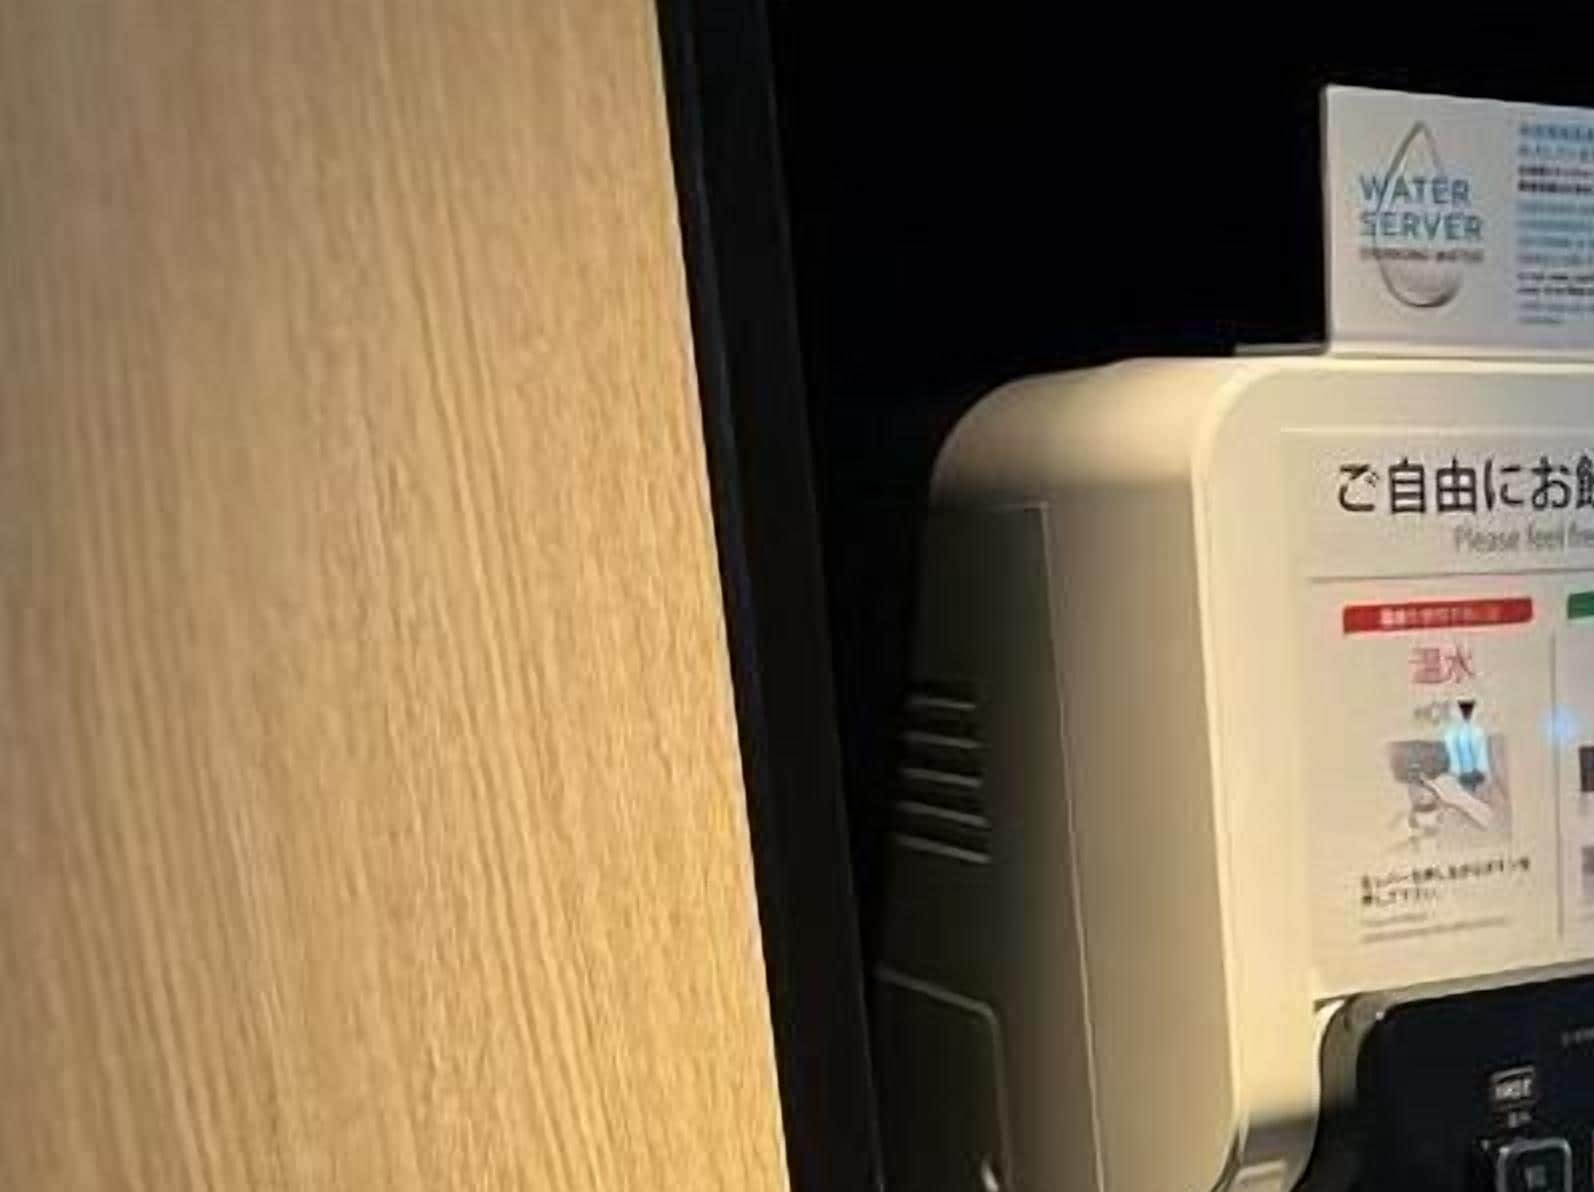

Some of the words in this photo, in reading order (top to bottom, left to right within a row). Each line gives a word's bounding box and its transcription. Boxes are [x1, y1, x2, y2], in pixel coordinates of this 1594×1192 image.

[1359, 174, 1470, 205] WATER
[1360, 211, 1482, 241] SERVER
[1454, 523, 1521, 553] Please
[1408, 643, 1476, 684] 温水
